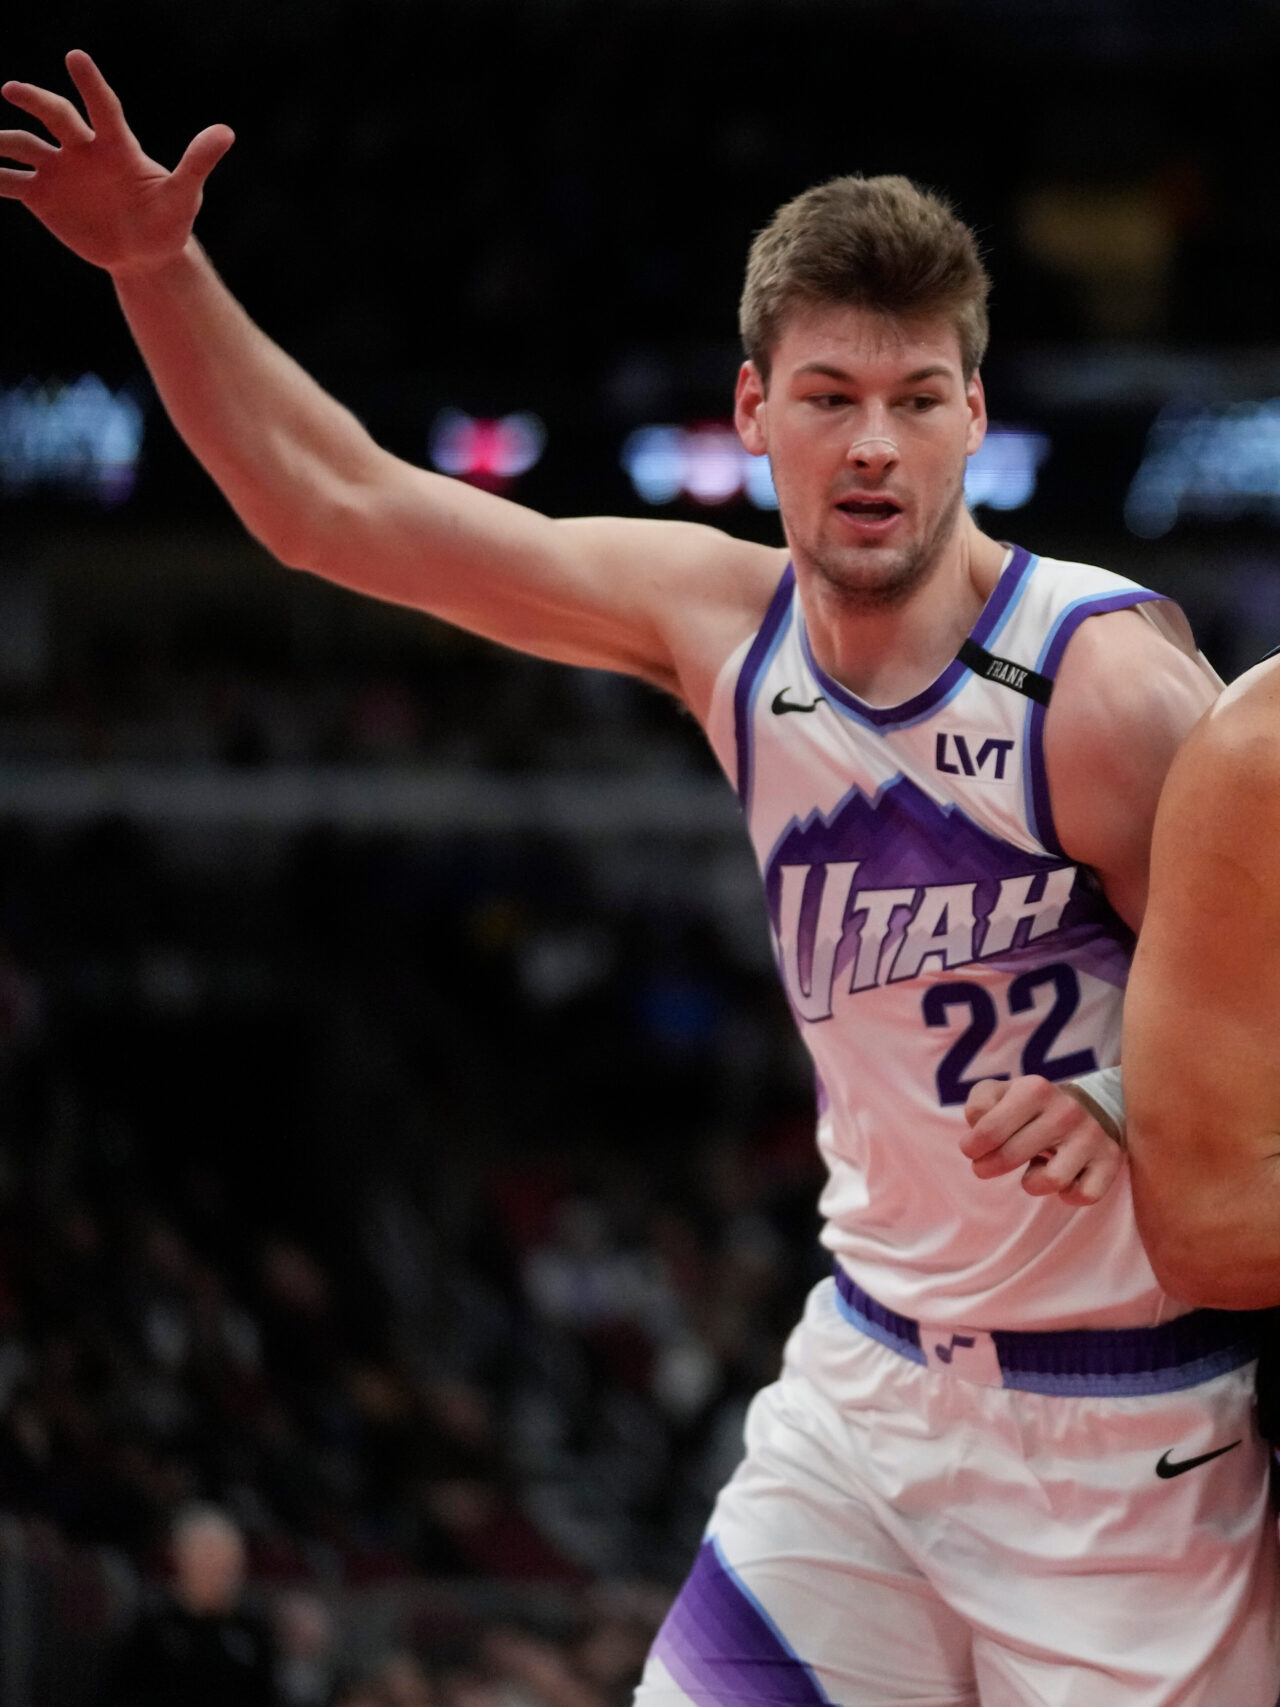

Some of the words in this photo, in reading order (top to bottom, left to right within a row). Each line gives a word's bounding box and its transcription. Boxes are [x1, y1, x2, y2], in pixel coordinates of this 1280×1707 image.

[986, 659, 1029, 689] FRANK
[935, 732, 1014, 780] LVT
[778, 861, 1077, 1023] UTAH
[921, 962, 1098, 1108] 22
